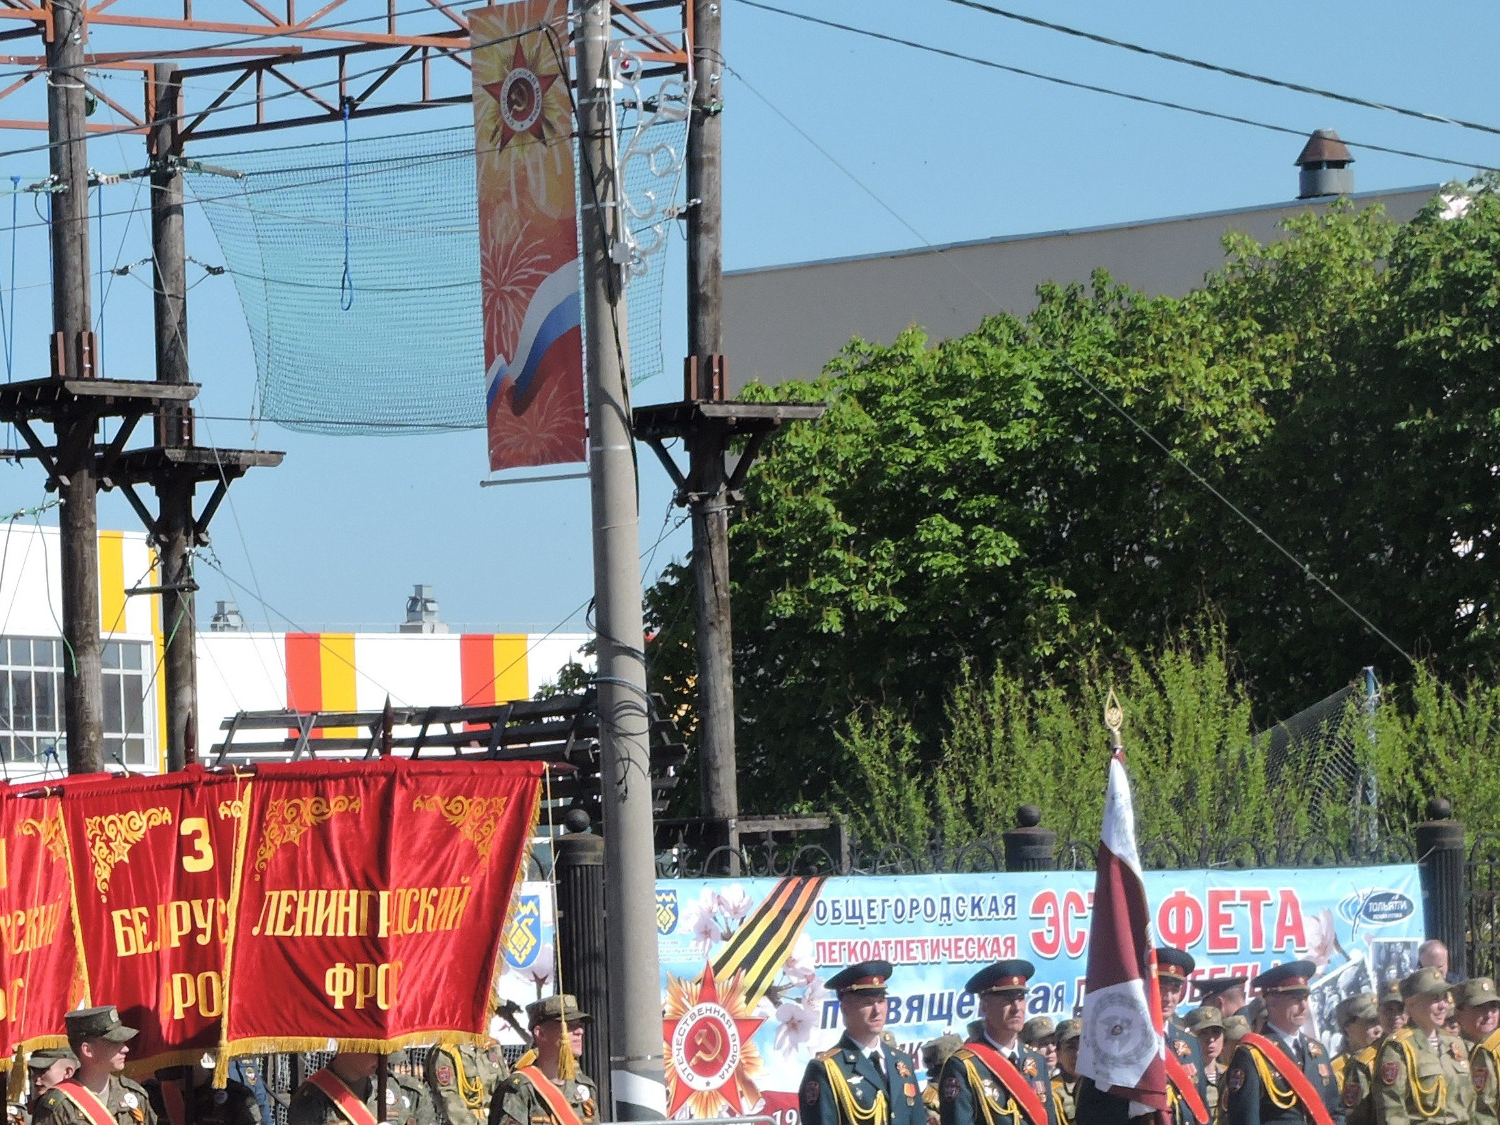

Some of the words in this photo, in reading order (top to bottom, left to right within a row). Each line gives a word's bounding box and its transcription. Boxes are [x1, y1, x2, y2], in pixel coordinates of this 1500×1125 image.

[181, 817, 214, 873] 3
[815, 895, 1016, 926] ОБЩЕГОРОДСКАЯ
[815, 936, 1016, 963] ЛЕГКОАТЛЕТИЧЕСКАЯ
[675, 1006, 733, 1082] ОТЕЧЕСТВЕННАЯ
